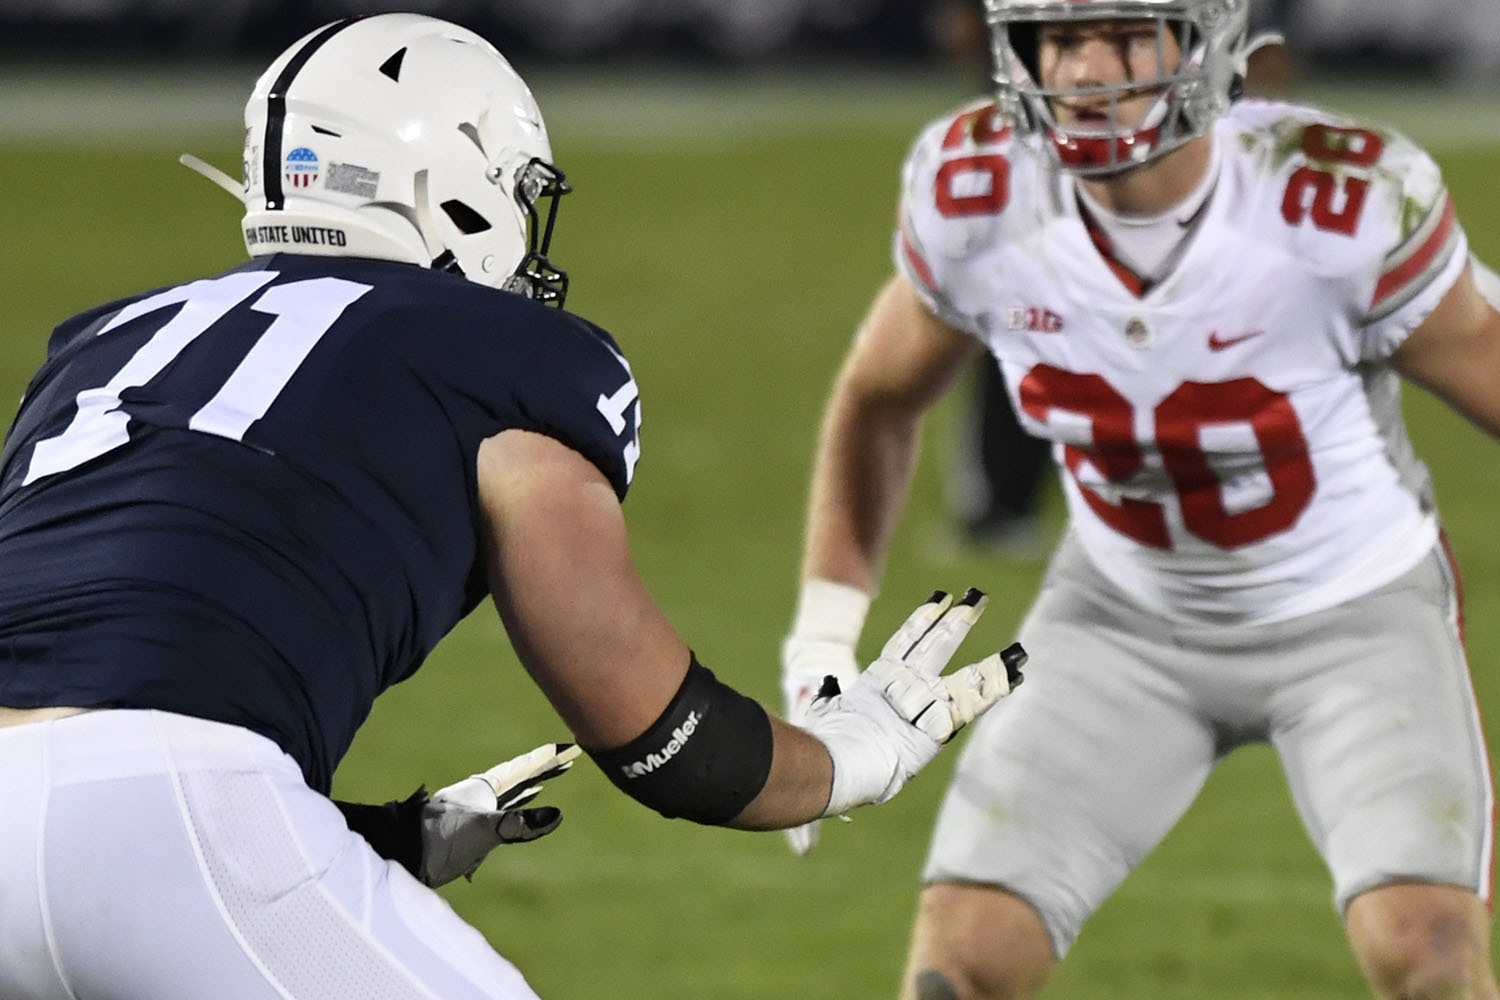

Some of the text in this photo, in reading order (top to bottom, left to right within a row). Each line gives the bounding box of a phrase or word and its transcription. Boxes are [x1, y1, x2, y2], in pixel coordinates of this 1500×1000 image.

[258, 226, 289, 243] STATE
[291, 225, 347, 247] UNITED
[21, 270, 374, 487] 71
[1018, 363, 1318, 551] 20
